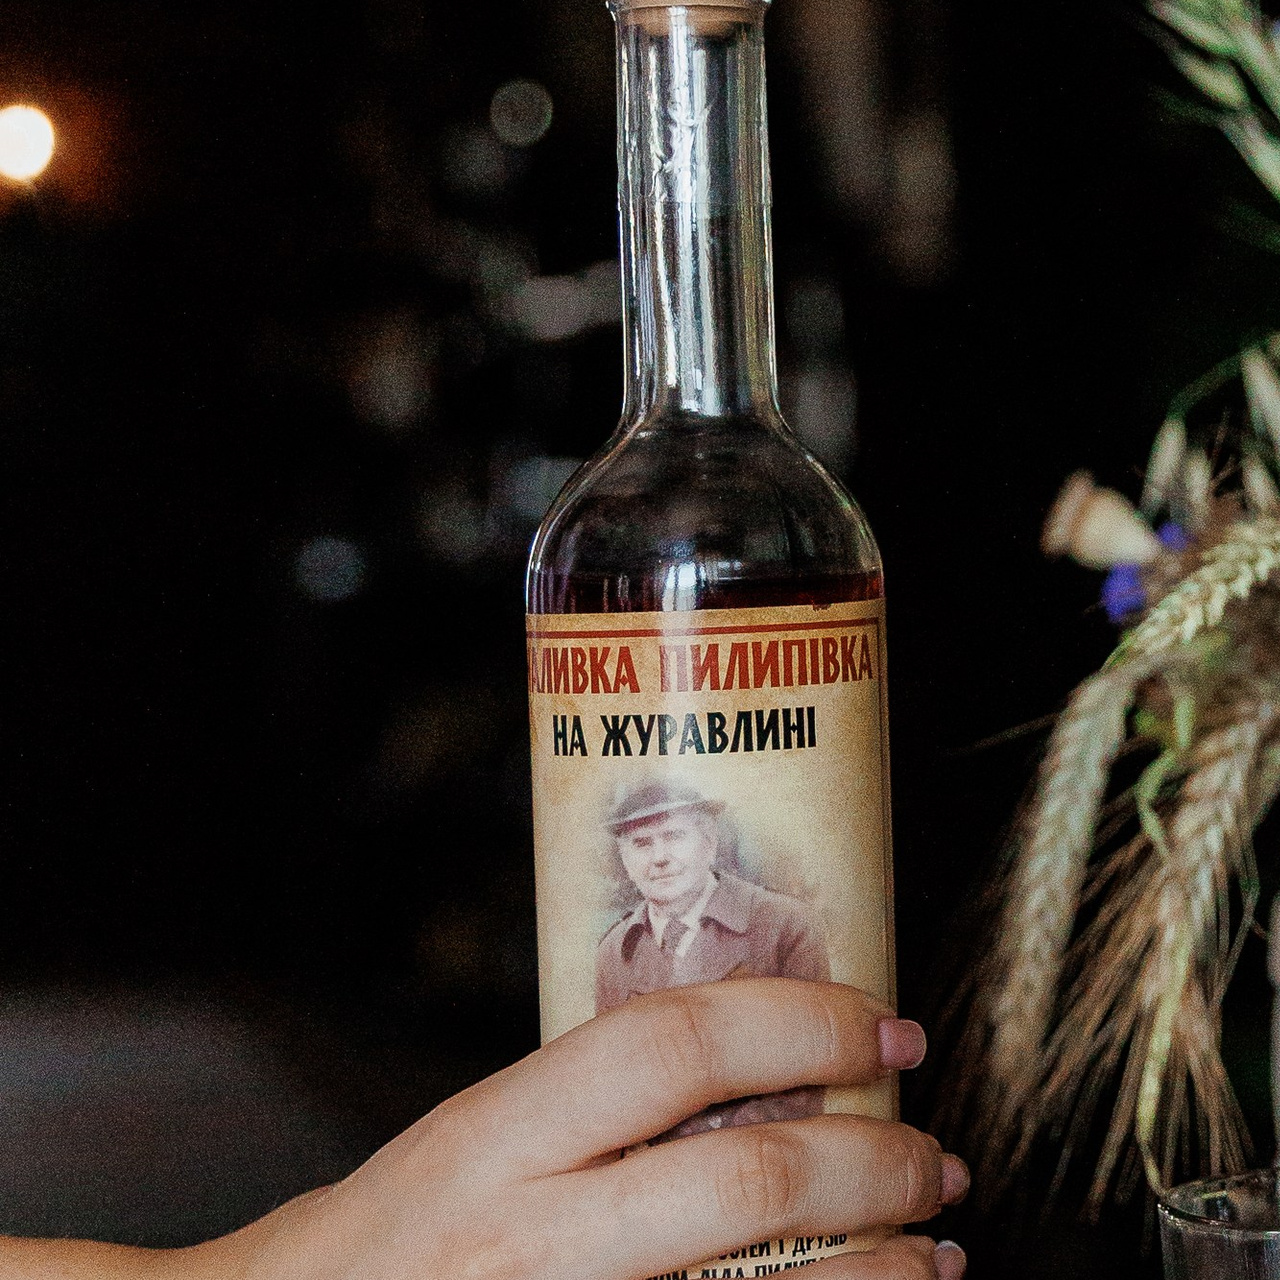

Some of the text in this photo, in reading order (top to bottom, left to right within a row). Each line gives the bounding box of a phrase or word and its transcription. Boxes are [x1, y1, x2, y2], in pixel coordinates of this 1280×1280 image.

[529, 633, 874, 694] АЛИВКА ПИЛИПІВКА
[552, 706, 817, 757] НА ЖУРАВЛИНІ
